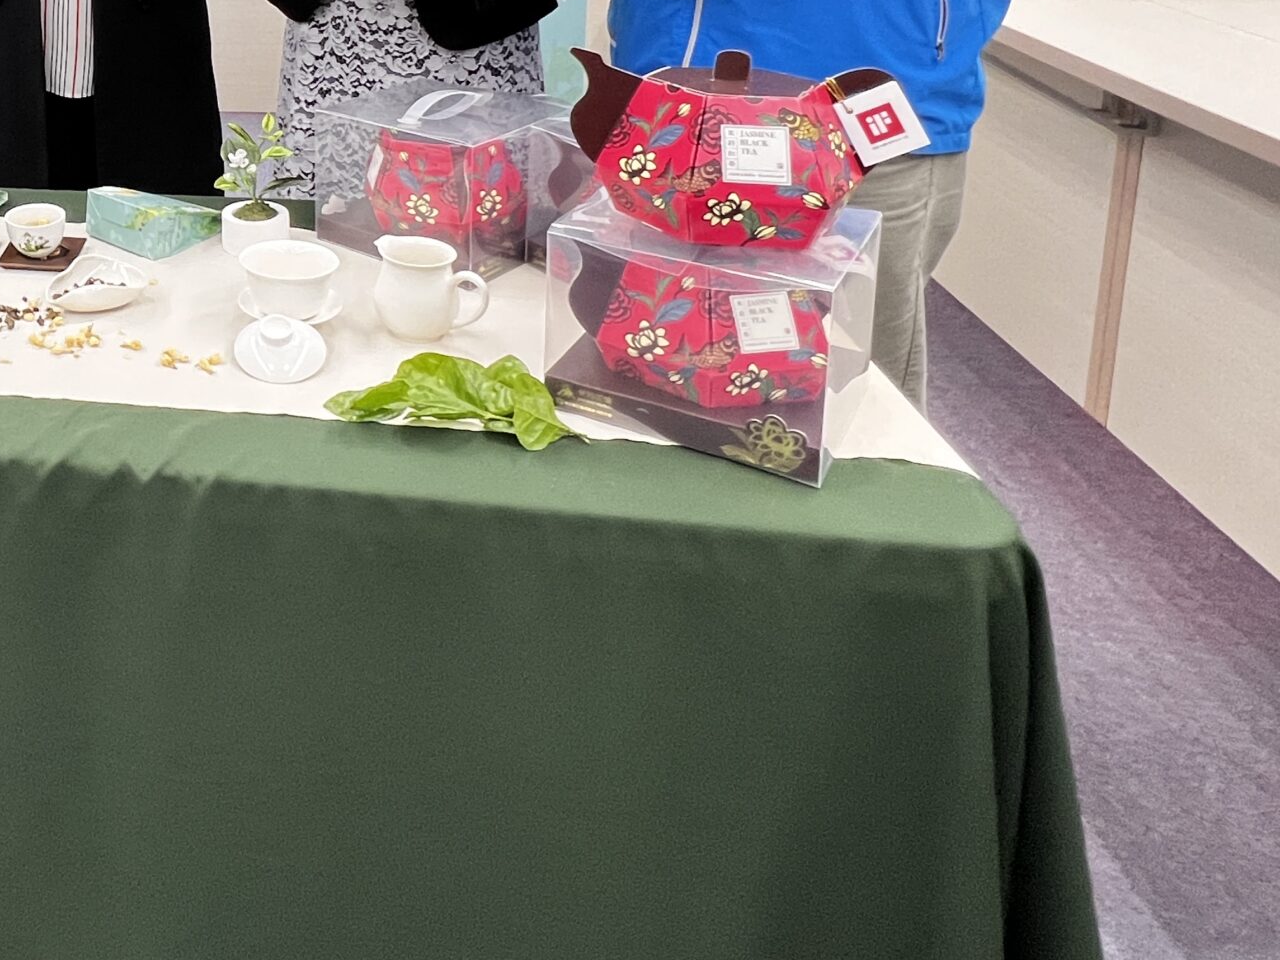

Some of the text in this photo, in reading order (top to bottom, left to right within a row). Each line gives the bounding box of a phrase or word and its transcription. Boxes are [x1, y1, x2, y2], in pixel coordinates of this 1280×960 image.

[740, 130, 776, 138] JASMINE
[740, 139, 769, 147] BLACK
[741, 148, 758, 156] TEA
